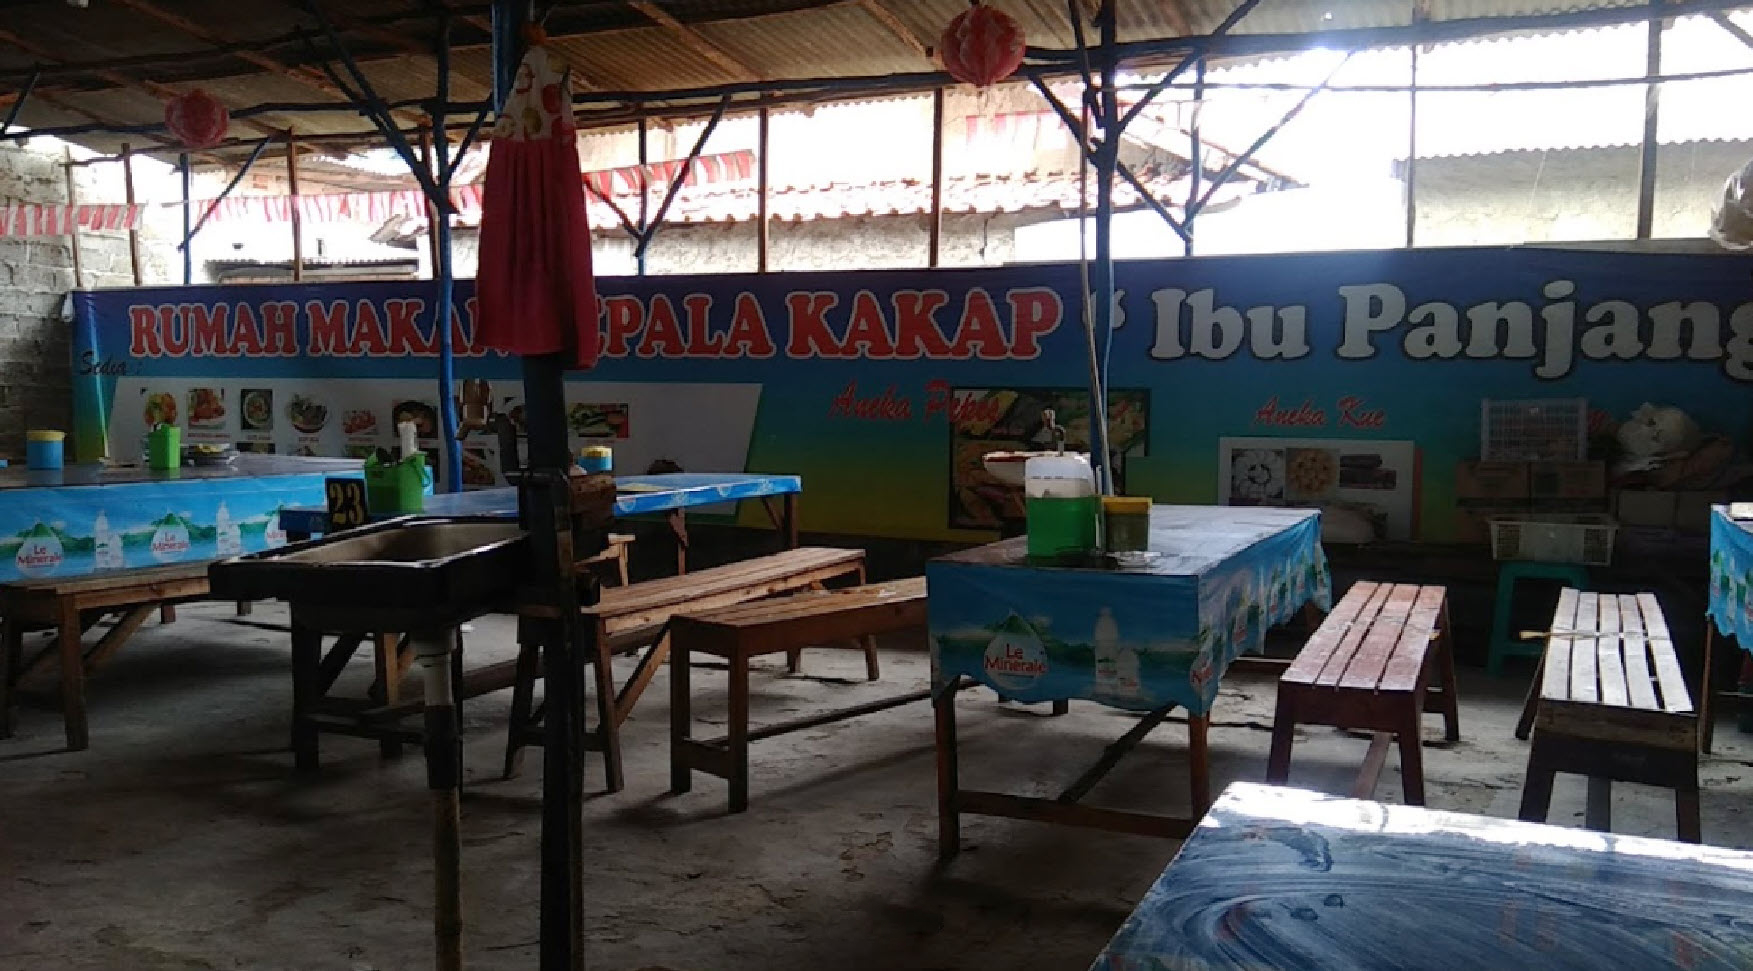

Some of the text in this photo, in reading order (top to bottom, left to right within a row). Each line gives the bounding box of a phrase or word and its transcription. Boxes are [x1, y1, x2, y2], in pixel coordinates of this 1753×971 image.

[129, 301, 299, 358] RUMAH
[595, 291, 778, 359] PALA
[785, 287, 1063, 361] KAKAP
[1149, 287, 1311, 360] Ibu
[827, 378, 912, 420] Aneka
[1253, 396, 1385, 428] Aneka Kue
[328, 482, 365, 524] 23
[164, 532, 176, 542] Le
[33, 544, 46, 555] Le
[16, 554, 62, 564] Minerale
[1005, 643, 1023, 659] Le
[984, 655, 1046, 672] Minerale
